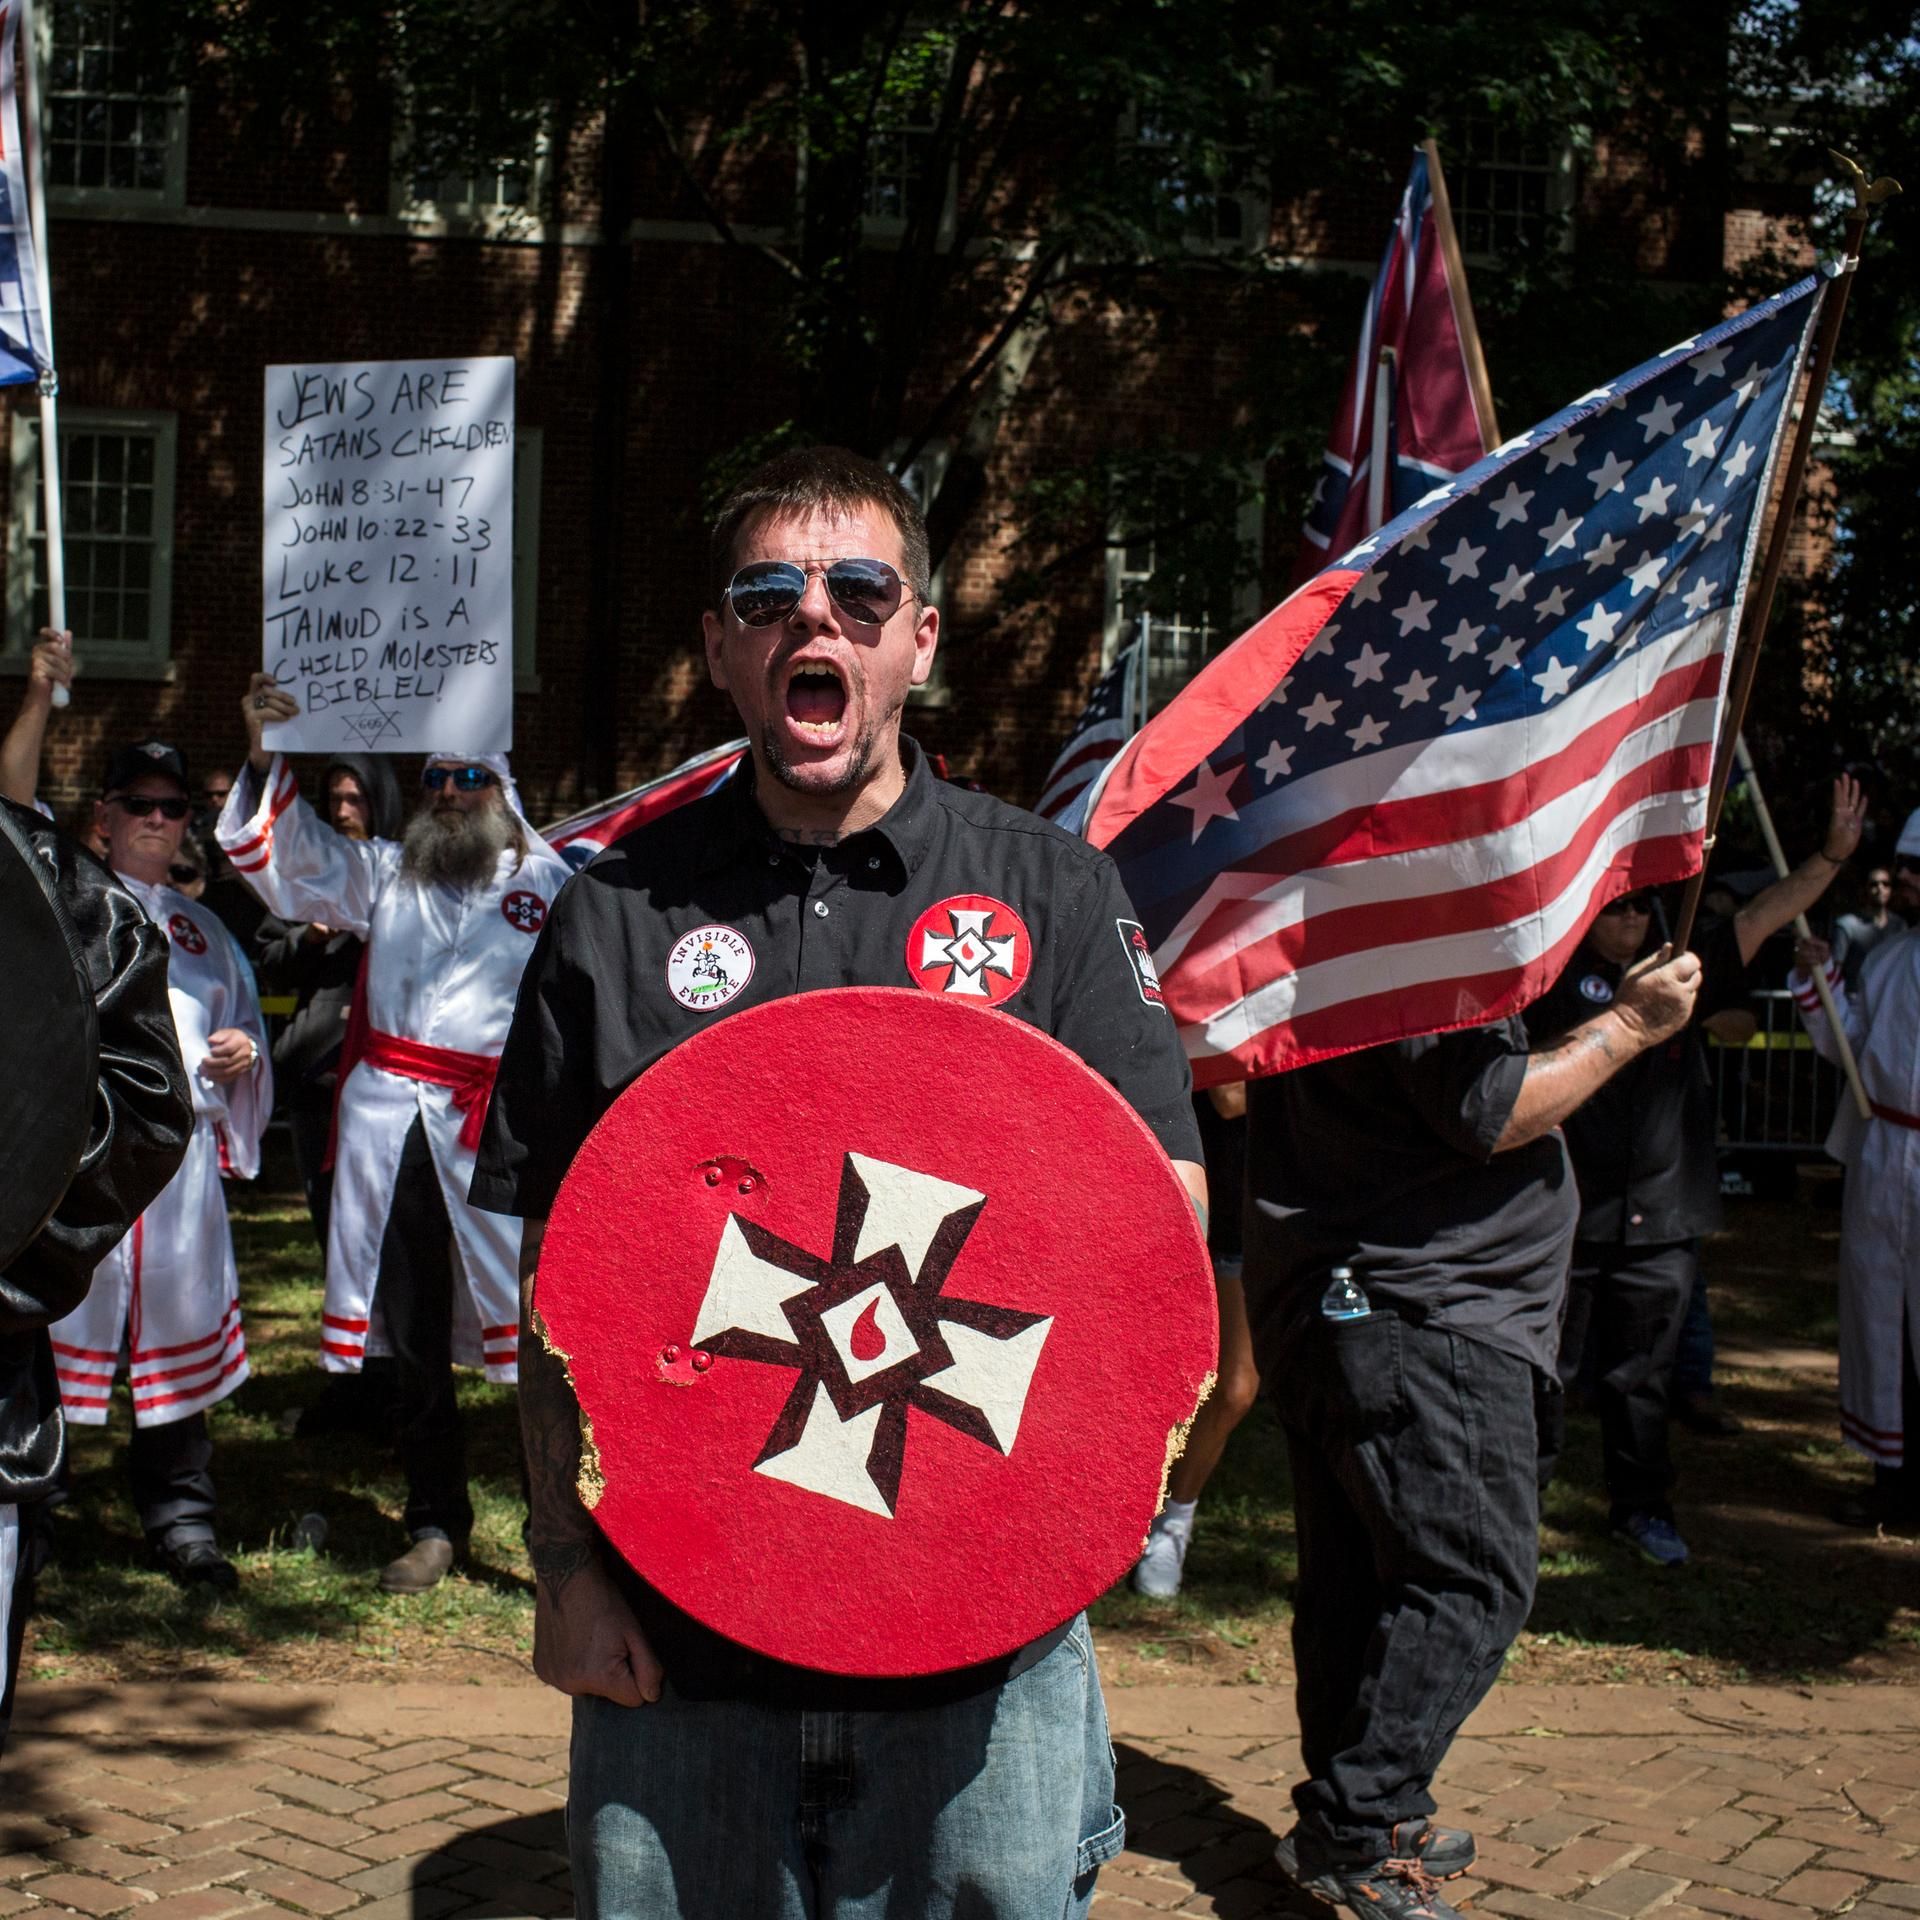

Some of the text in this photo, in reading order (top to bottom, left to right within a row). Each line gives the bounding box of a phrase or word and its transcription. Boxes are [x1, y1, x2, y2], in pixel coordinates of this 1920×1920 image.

[277, 369, 470, 431] JEWS ARE
[279, 428, 382, 468] SATANS
[279, 554, 370, 601] Luke
[445, 596, 471, 628] A
[273, 647, 369, 685] CHILD
[672, 931, 746, 965] INVISIBLE
[678, 978, 740, 1006] EMPIRE
